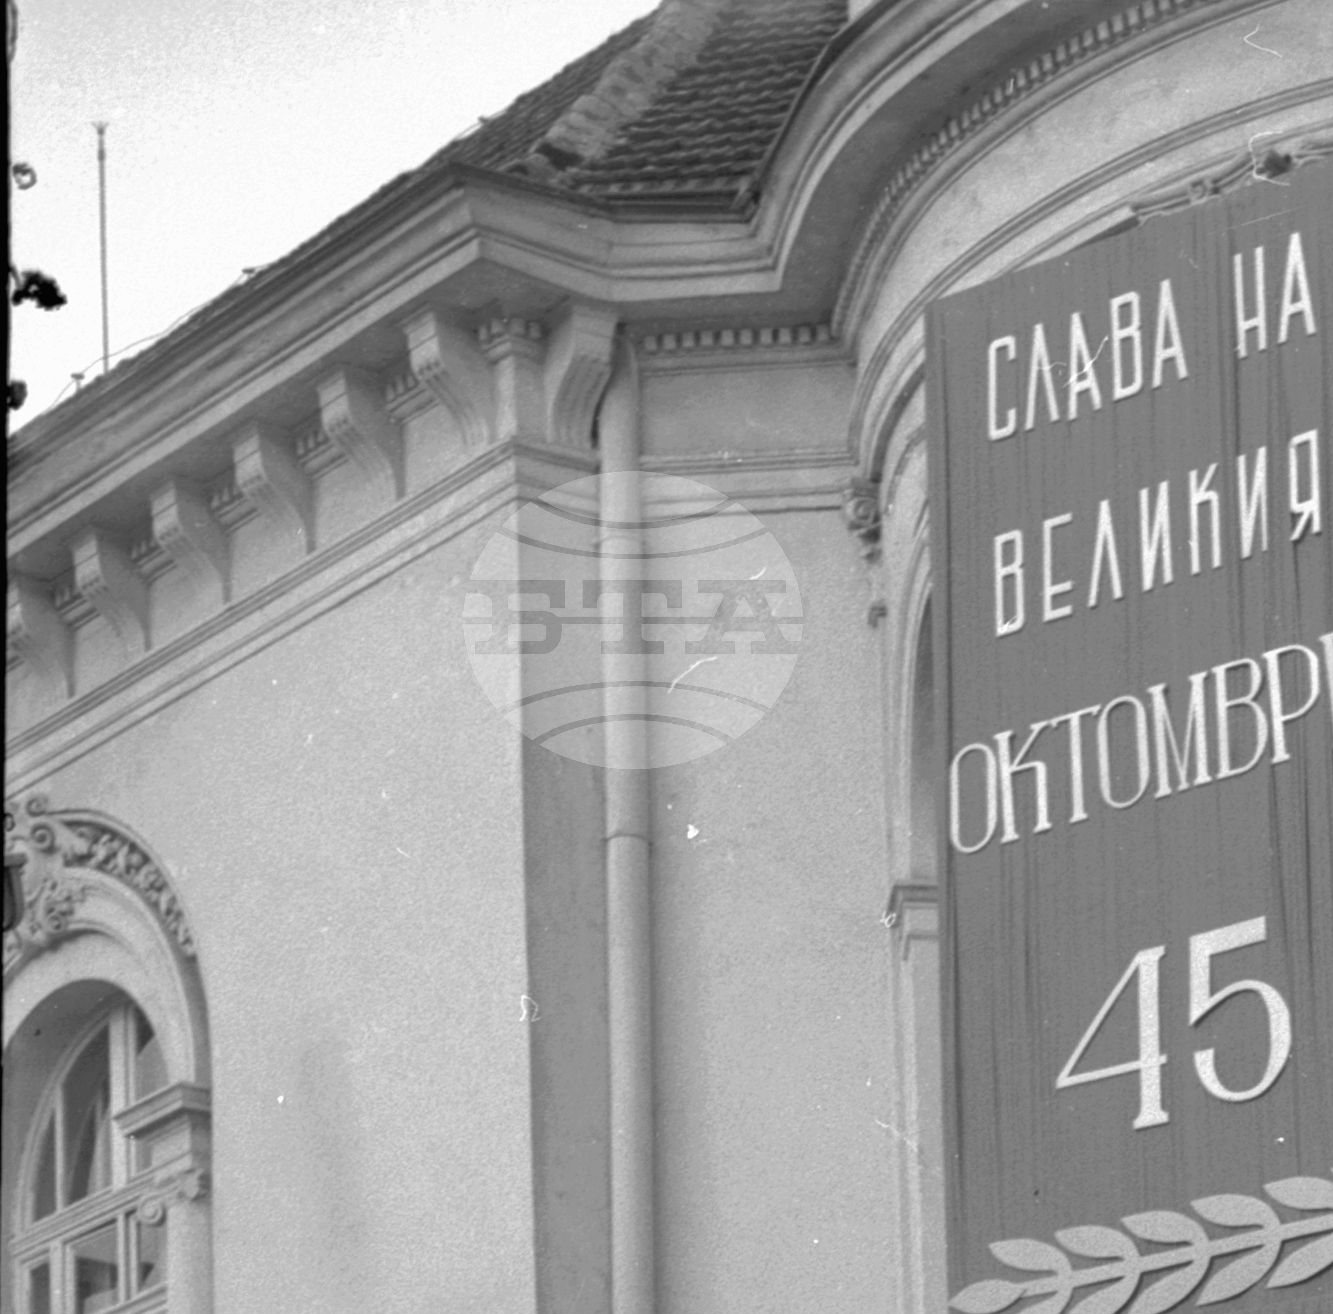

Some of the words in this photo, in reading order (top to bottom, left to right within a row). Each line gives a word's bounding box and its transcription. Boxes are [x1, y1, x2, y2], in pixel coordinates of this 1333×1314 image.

[988, 280, 1188, 441] СЛАВА
[1234, 232, 1316, 358] НА
[994, 430, 1322, 637] ВЕЛИКИЯ
[1055, 916, 1292, 1131] 45
